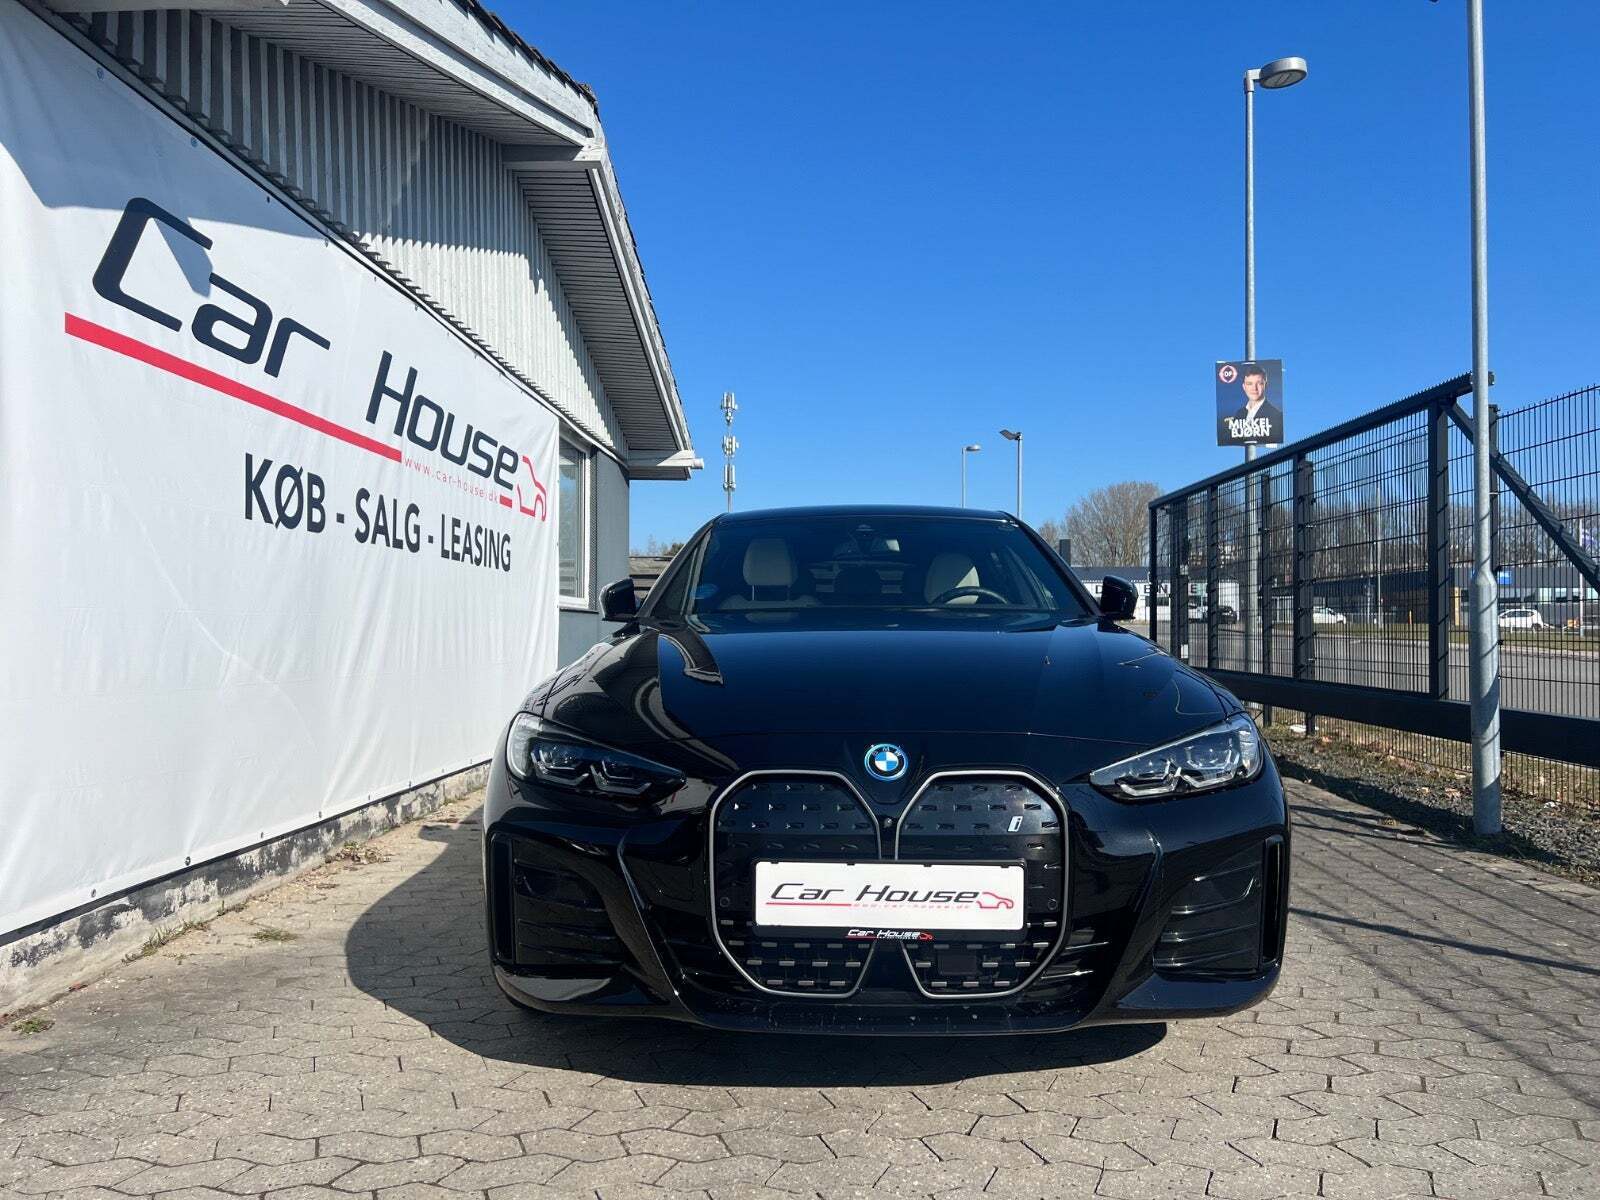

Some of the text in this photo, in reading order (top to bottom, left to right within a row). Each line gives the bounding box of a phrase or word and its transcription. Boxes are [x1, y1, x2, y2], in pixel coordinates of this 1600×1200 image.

[92, 197, 519, 491] Car House
[1231, 427, 1270, 438] BJØRN
[404, 457, 499, 504] www.car-house.dk
[244, 452, 326, 533] KØB
[355, 487, 421, 553] SALG
[440, 513, 511, 572] LEASING
[770, 883, 980, 903] Car House
[847, 928, 874, 937] Car
[876, 929, 921, 938] House
